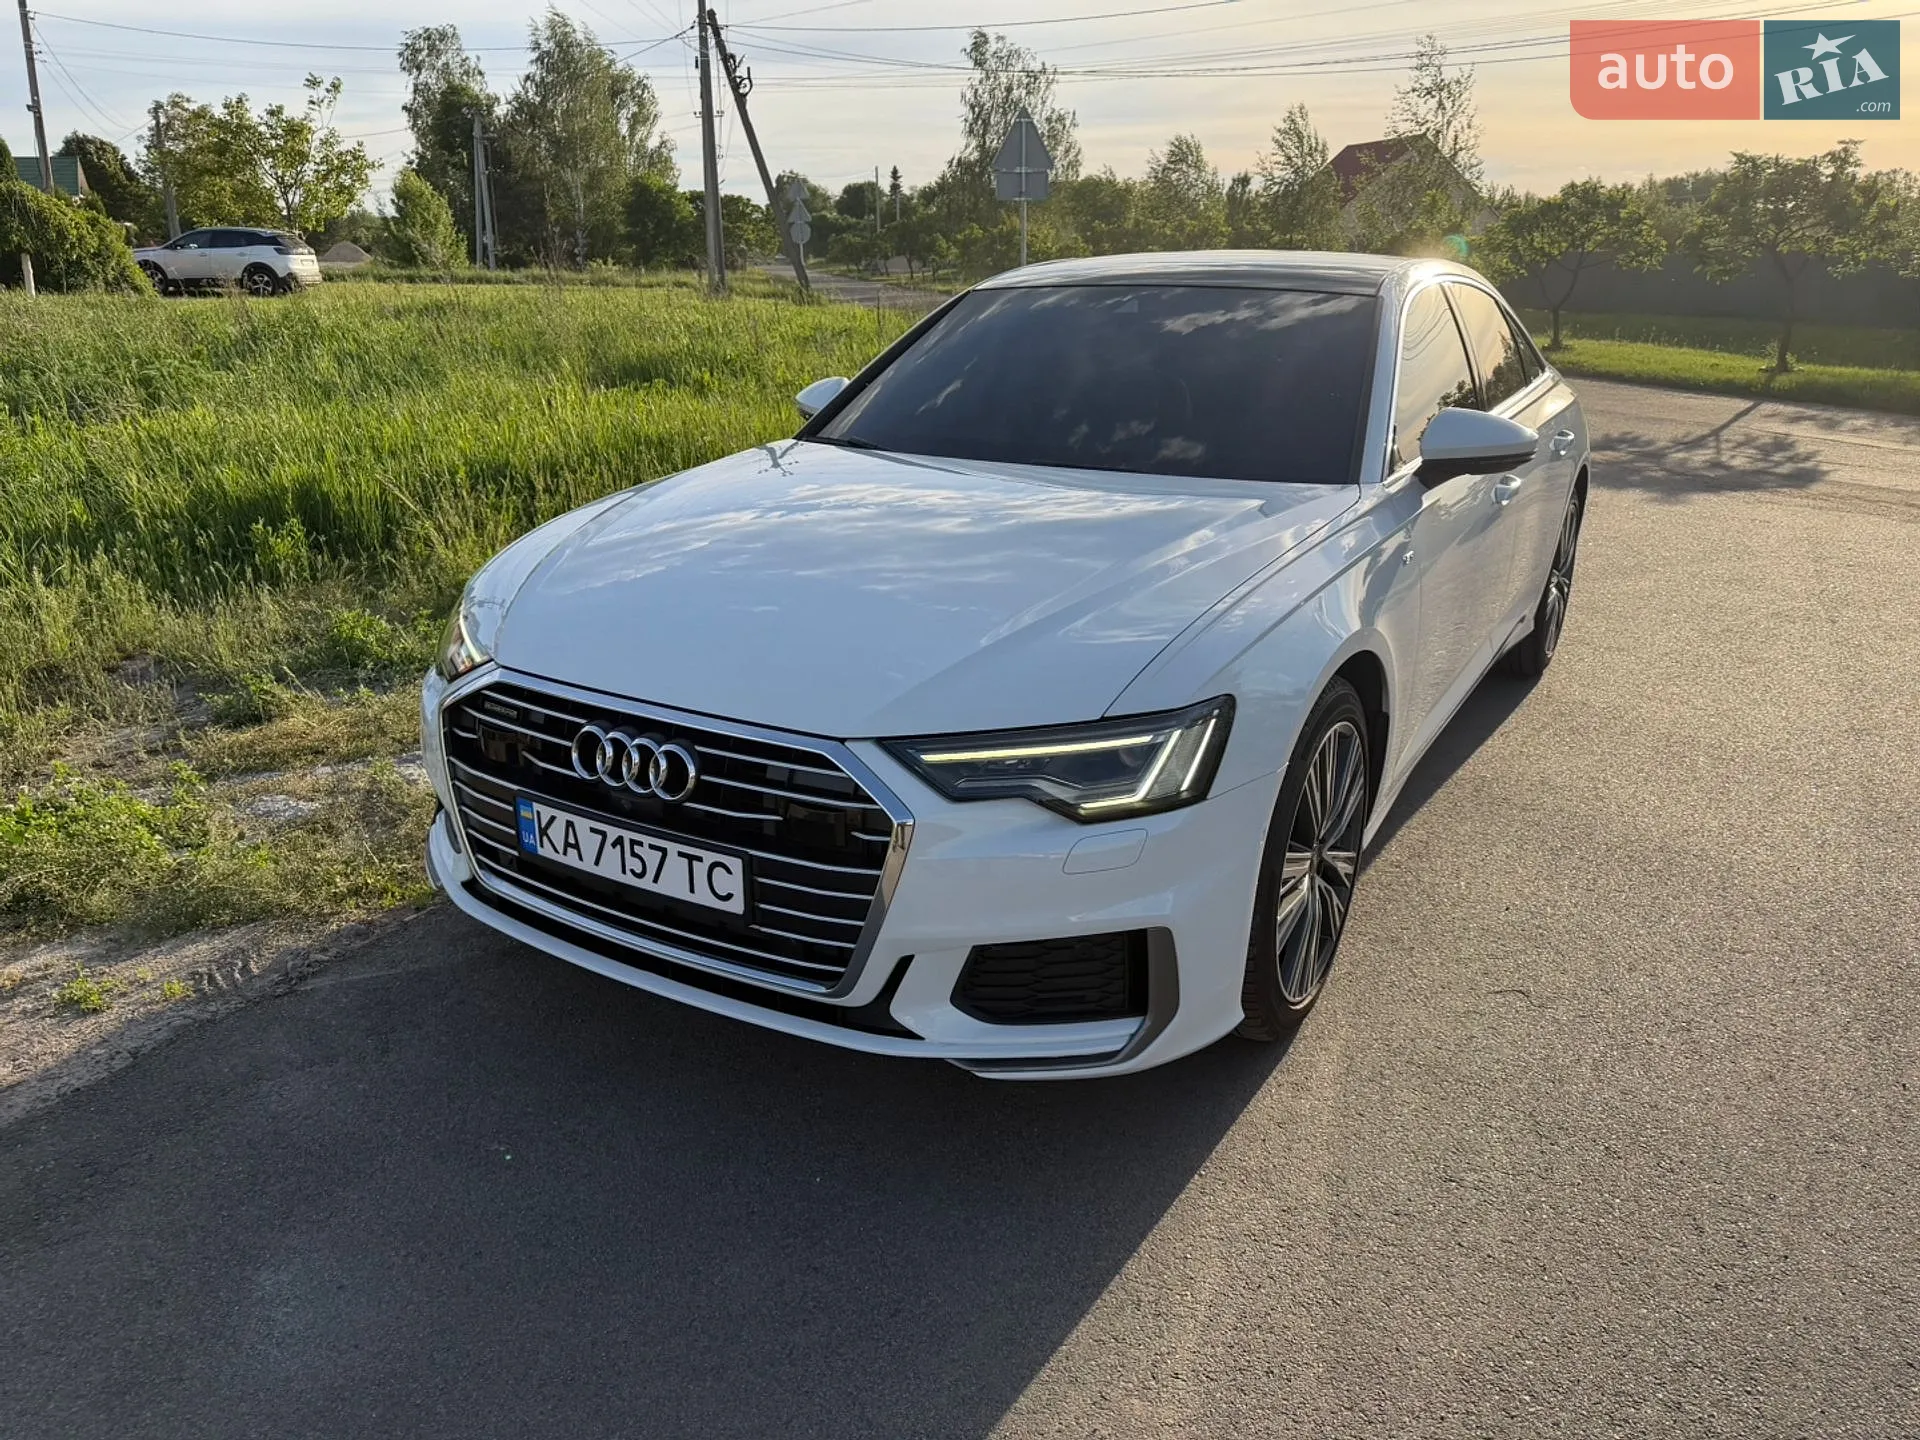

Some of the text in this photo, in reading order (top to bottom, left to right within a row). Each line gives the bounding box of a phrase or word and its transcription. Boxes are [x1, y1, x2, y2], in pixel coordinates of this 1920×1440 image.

[522, 831, 536, 847] UA
[536, 809, 734, 902] KA 7157 TC
